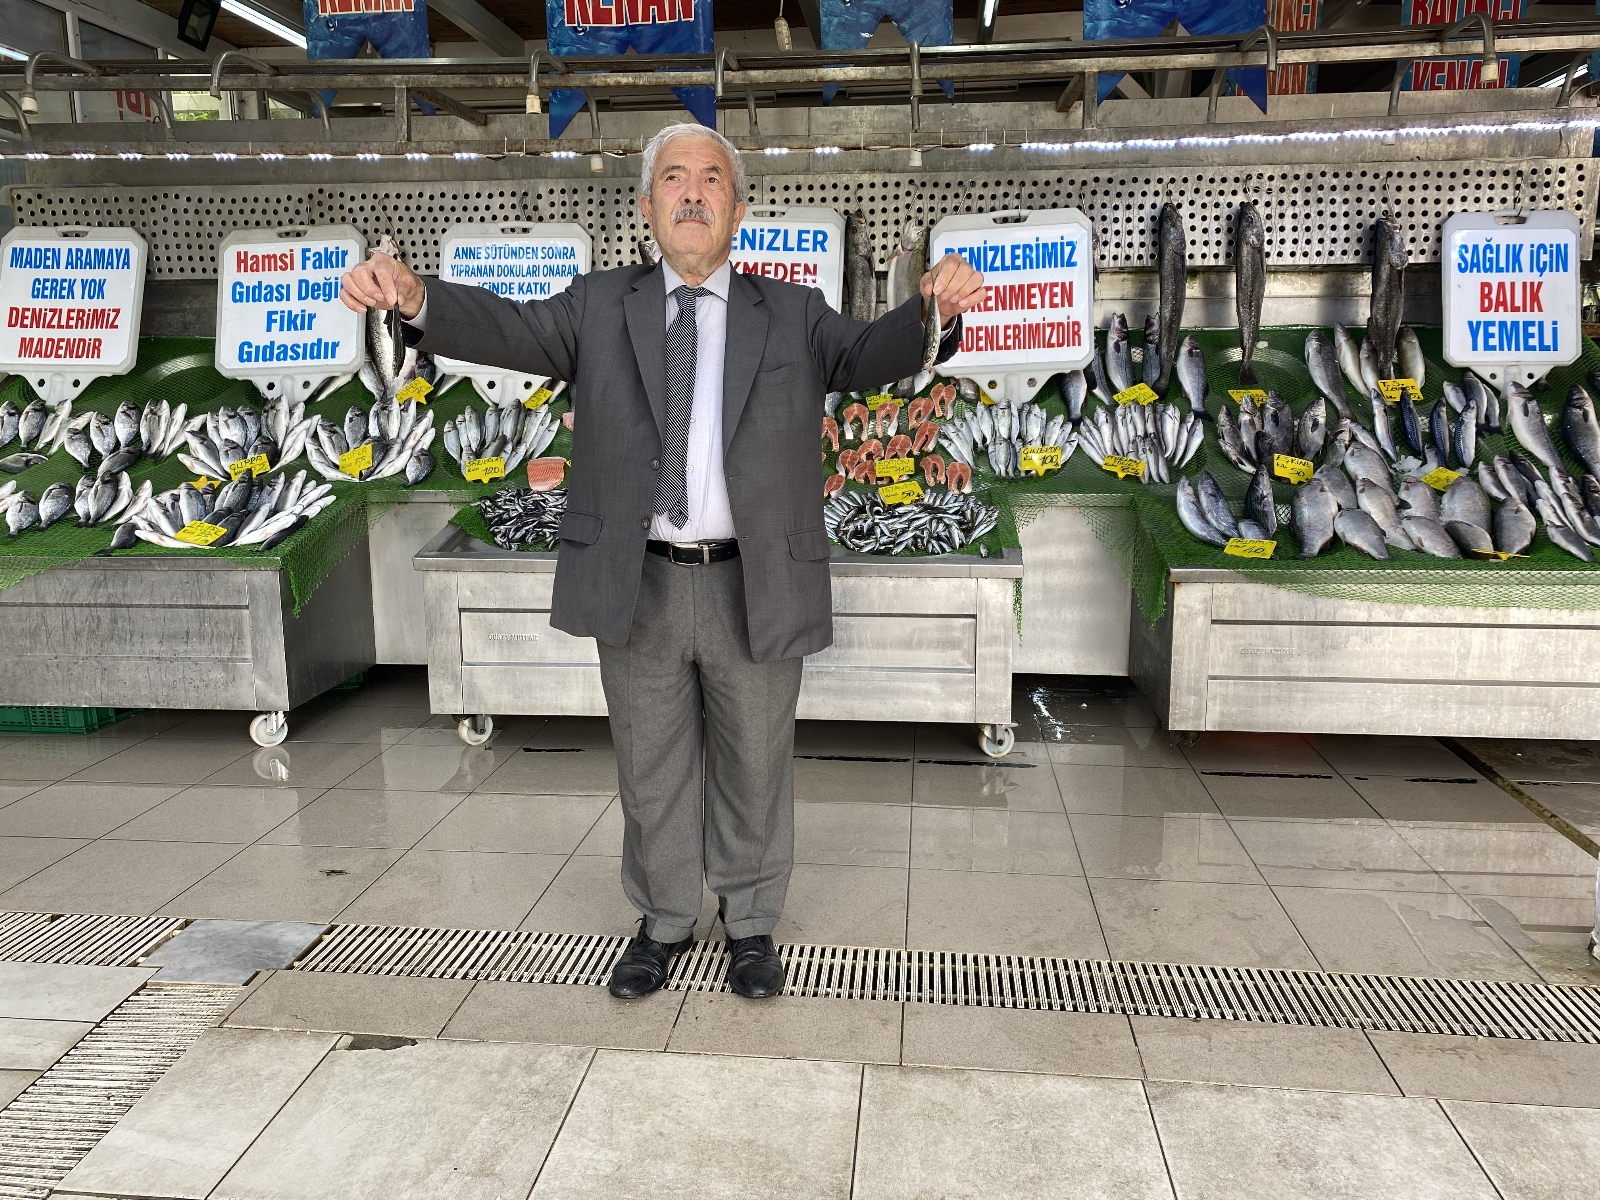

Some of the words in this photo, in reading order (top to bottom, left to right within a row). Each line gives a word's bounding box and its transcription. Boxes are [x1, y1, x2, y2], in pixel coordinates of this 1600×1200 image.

[9, 247, 61, 269] MADEN
[65, 248, 131, 270] ARAMAYA
[236, 249, 295, 273] Hamsi
[301, 246, 349, 270] Fakir
[453, 246, 482, 260] ANNE
[484, 243, 539, 260] SÜTÜNDEN
[540, 246, 576, 260] SONRA
[1457, 236, 1525, 274] SAĞLIK
[451, 264, 495, 278] YIPRANAN
[496, 264, 541, 278] DOKULARI
[542, 264, 579, 277] ONARAN
[31, 278, 77, 300] GEREK
[80, 279, 107, 300] YOK
[231, 281, 291, 303] Gıdası
[297, 276, 345, 303] Deği
[517, 281, 551, 295] KATKI
[1479, 281, 1544, 313] BALIK
[265, 309, 317, 333] Fikir
[238, 338, 340, 363] Gıdasıdır
